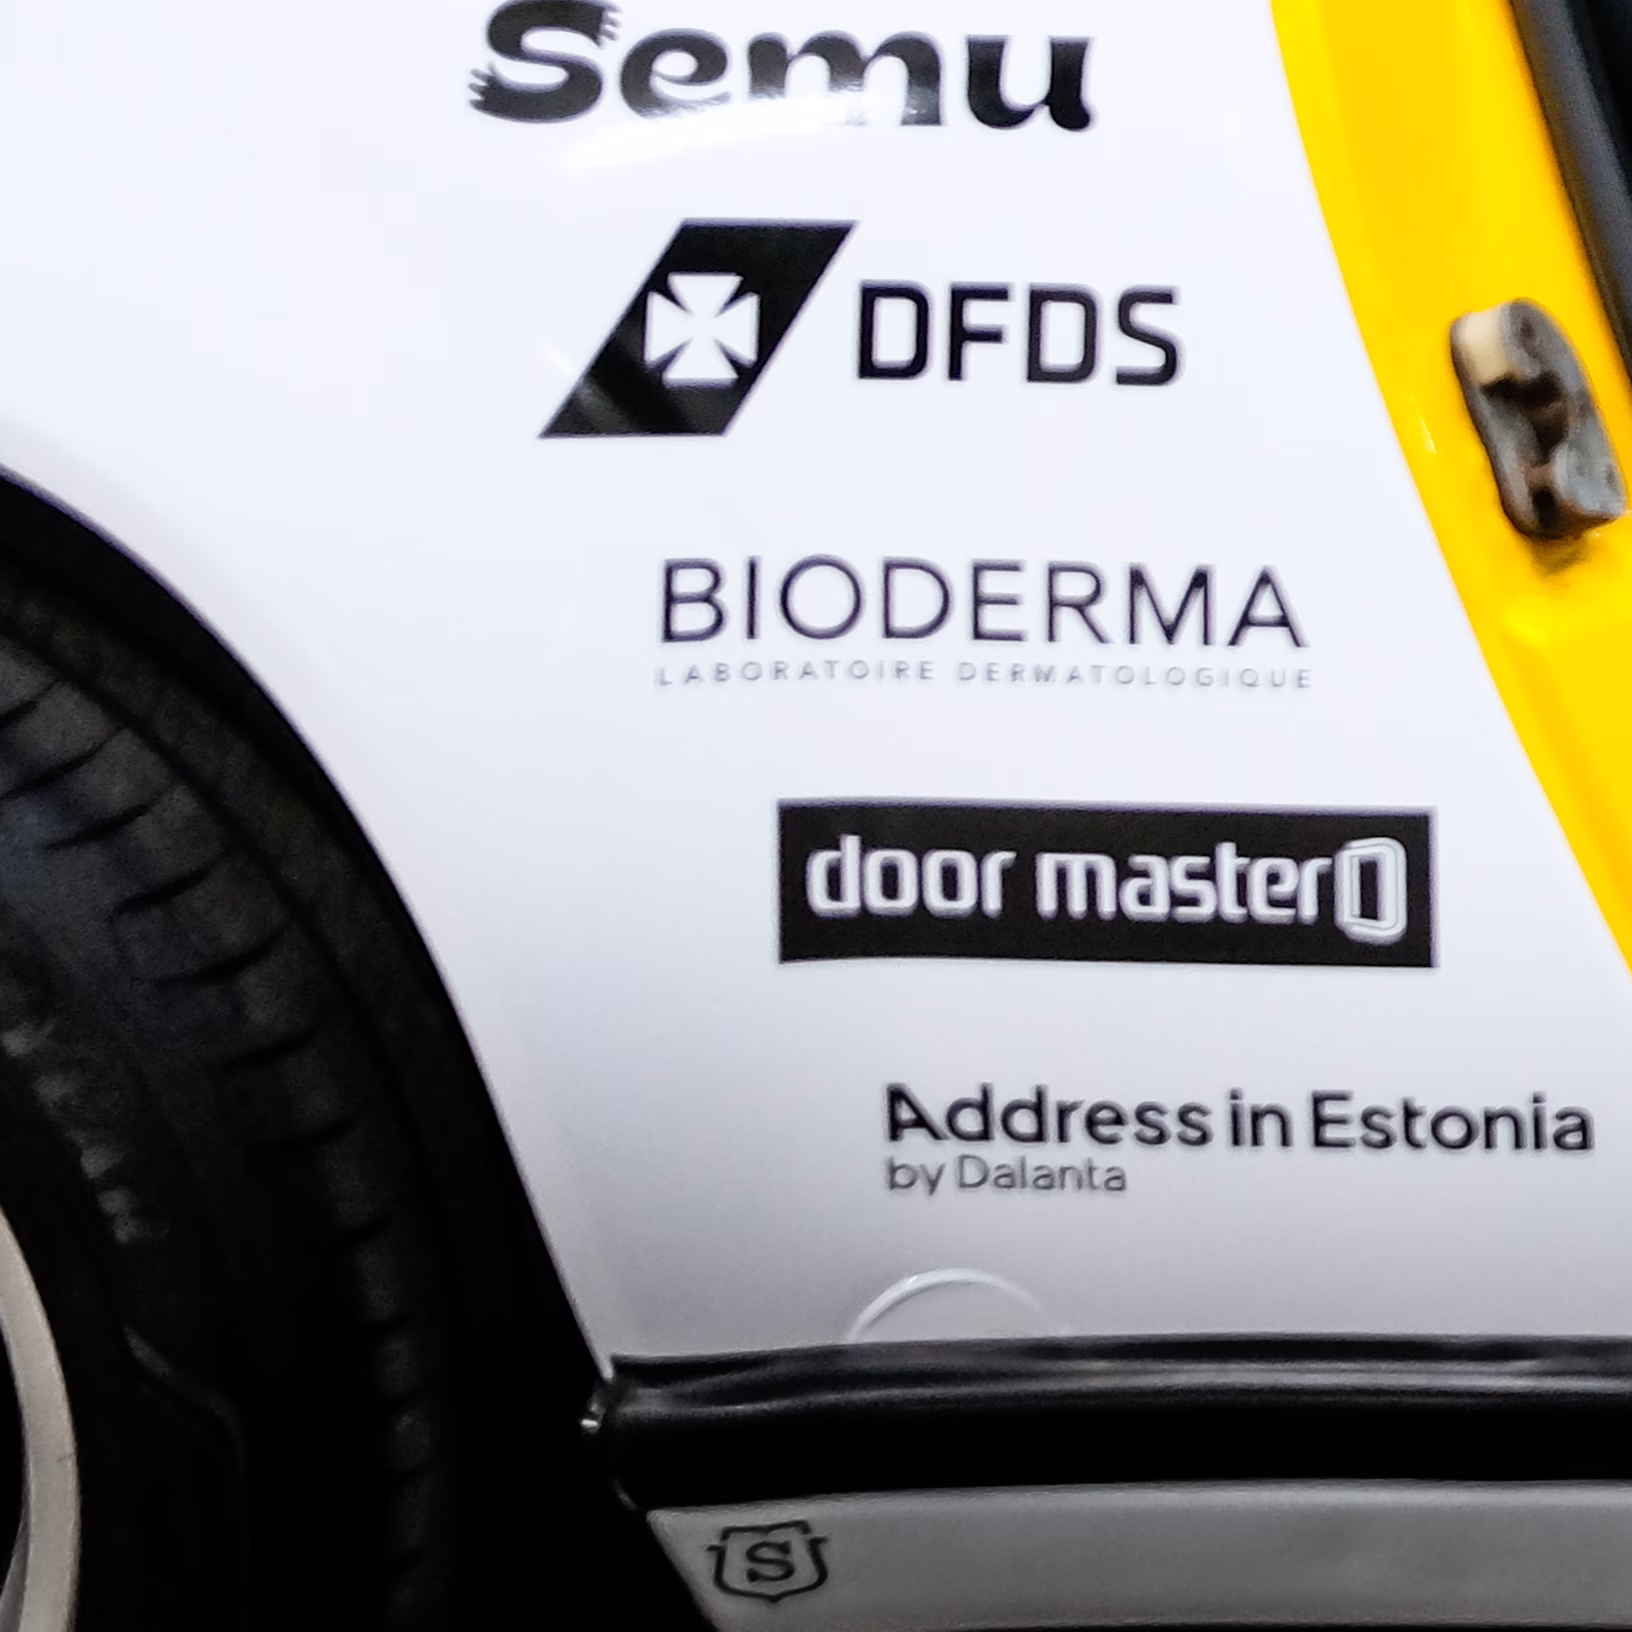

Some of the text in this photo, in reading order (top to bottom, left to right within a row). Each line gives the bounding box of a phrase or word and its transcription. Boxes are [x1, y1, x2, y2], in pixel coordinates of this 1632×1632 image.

[857, 279, 1183, 386] DFDS
[660, 554, 1310, 648] BIODERMA
[655, 659, 1313, 690] LABORATOIRE DERMATOLOGIQUE
[805, 834, 1017, 918] door
[885, 1081, 1596, 1153] Address in Estonia
[886, 1152, 1128, 1197] by Dalanta
